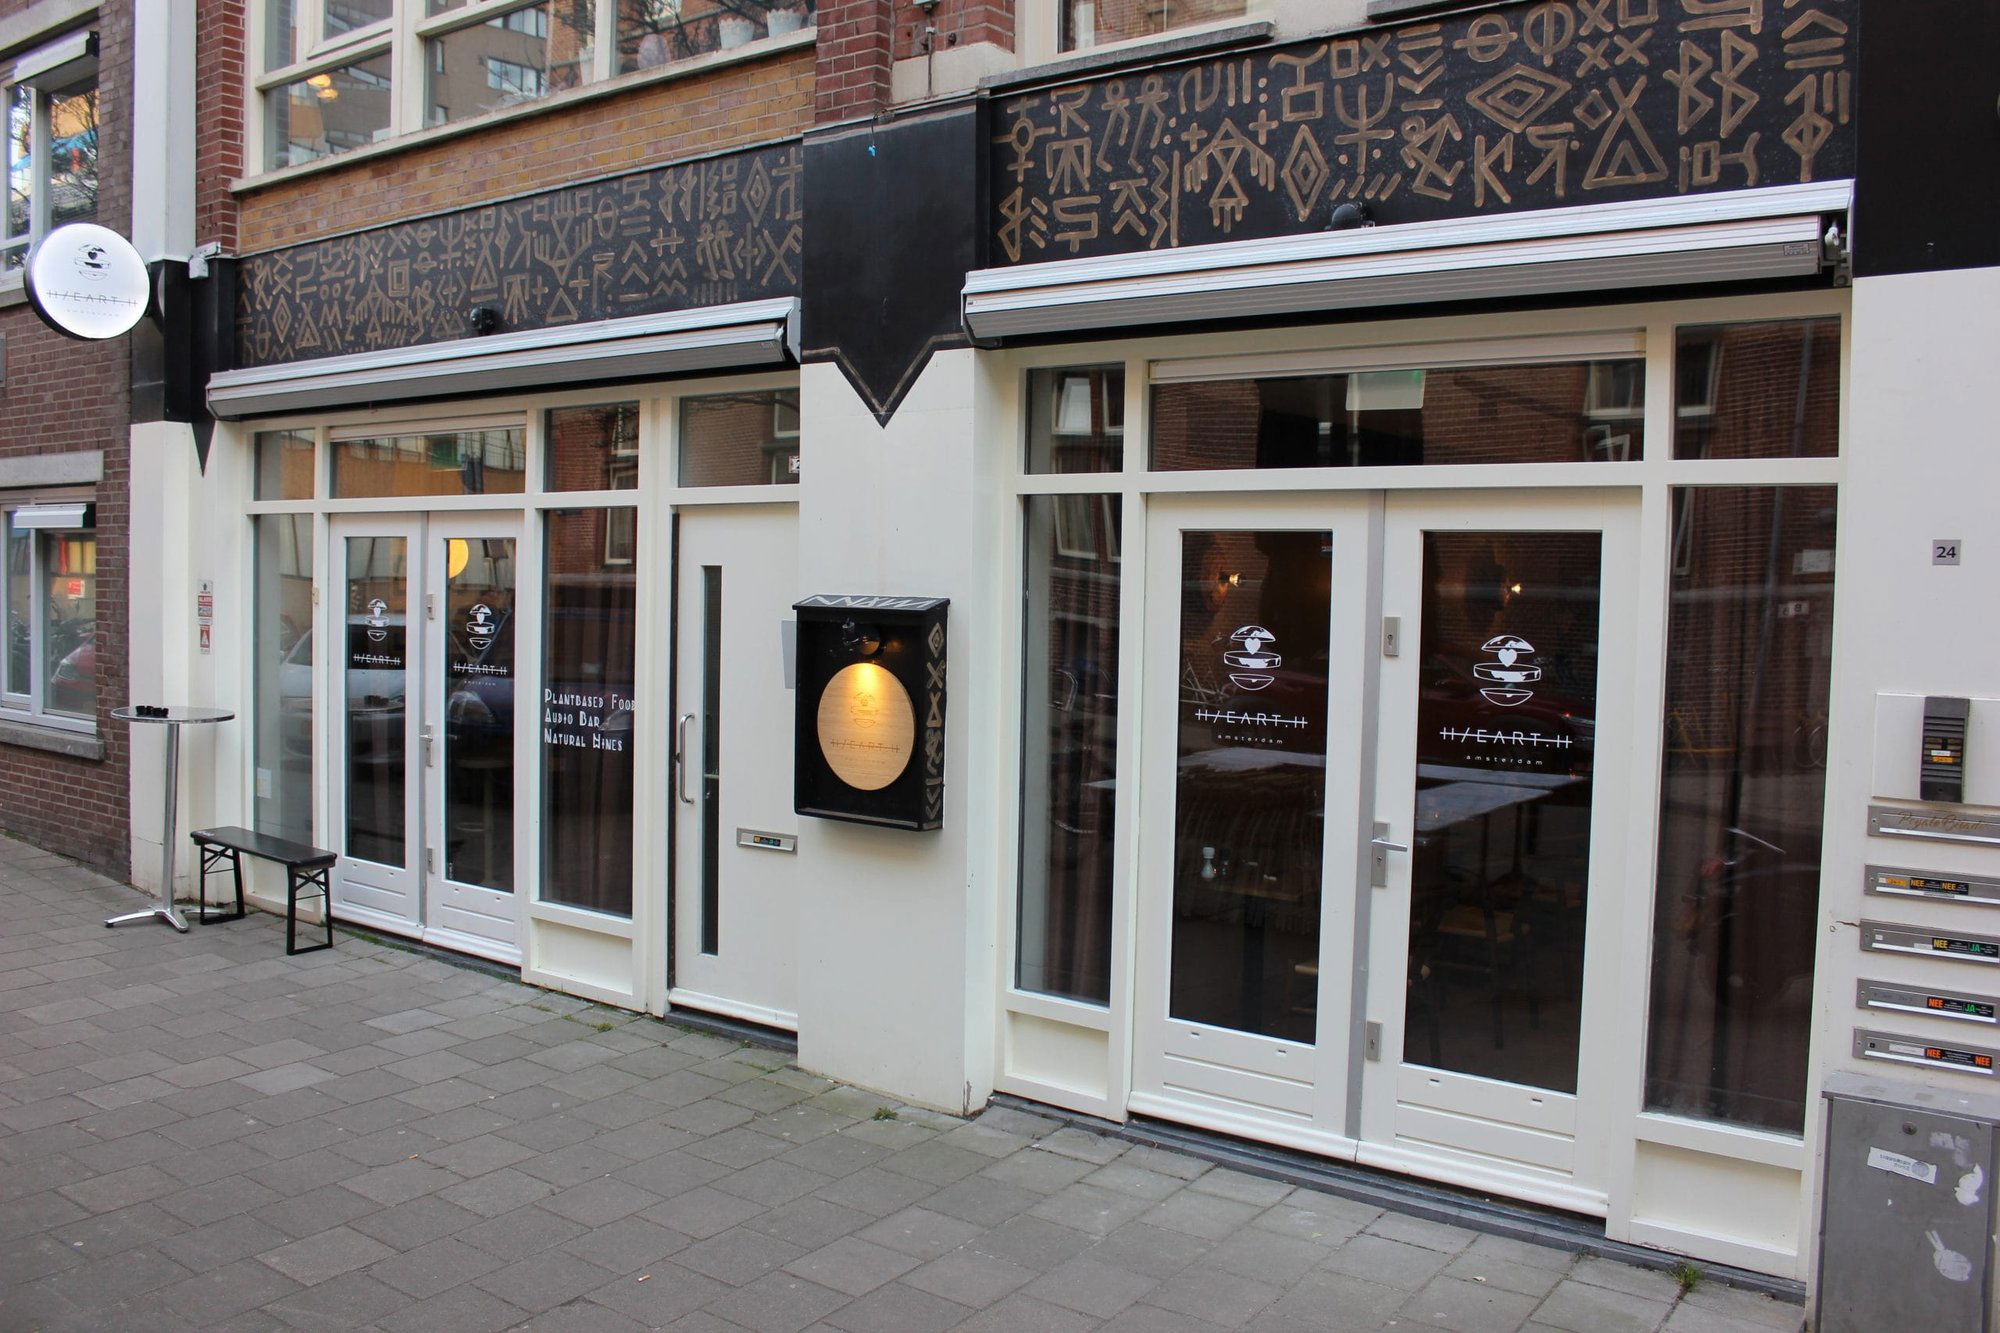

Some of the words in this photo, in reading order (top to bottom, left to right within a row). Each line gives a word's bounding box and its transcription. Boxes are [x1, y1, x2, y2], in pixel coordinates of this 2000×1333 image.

[1936, 546, 1956, 559] 24
[1217, 734, 1283, 744] amsterdam
[1465, 755, 1543, 766] amsterdam
[1910, 879, 1925, 888] NEE
[1941, 882, 1957, 891] NEE
[1933, 938, 1948, 949] NEE
[1970, 944, 1981, 953] JA
[1928, 998, 1943, 1008] NEE
[1965, 1004, 1976, 1013] JA
[1926, 1048, 1941, 1059] NEE
[1975, 1056, 1990, 1066] NEE
